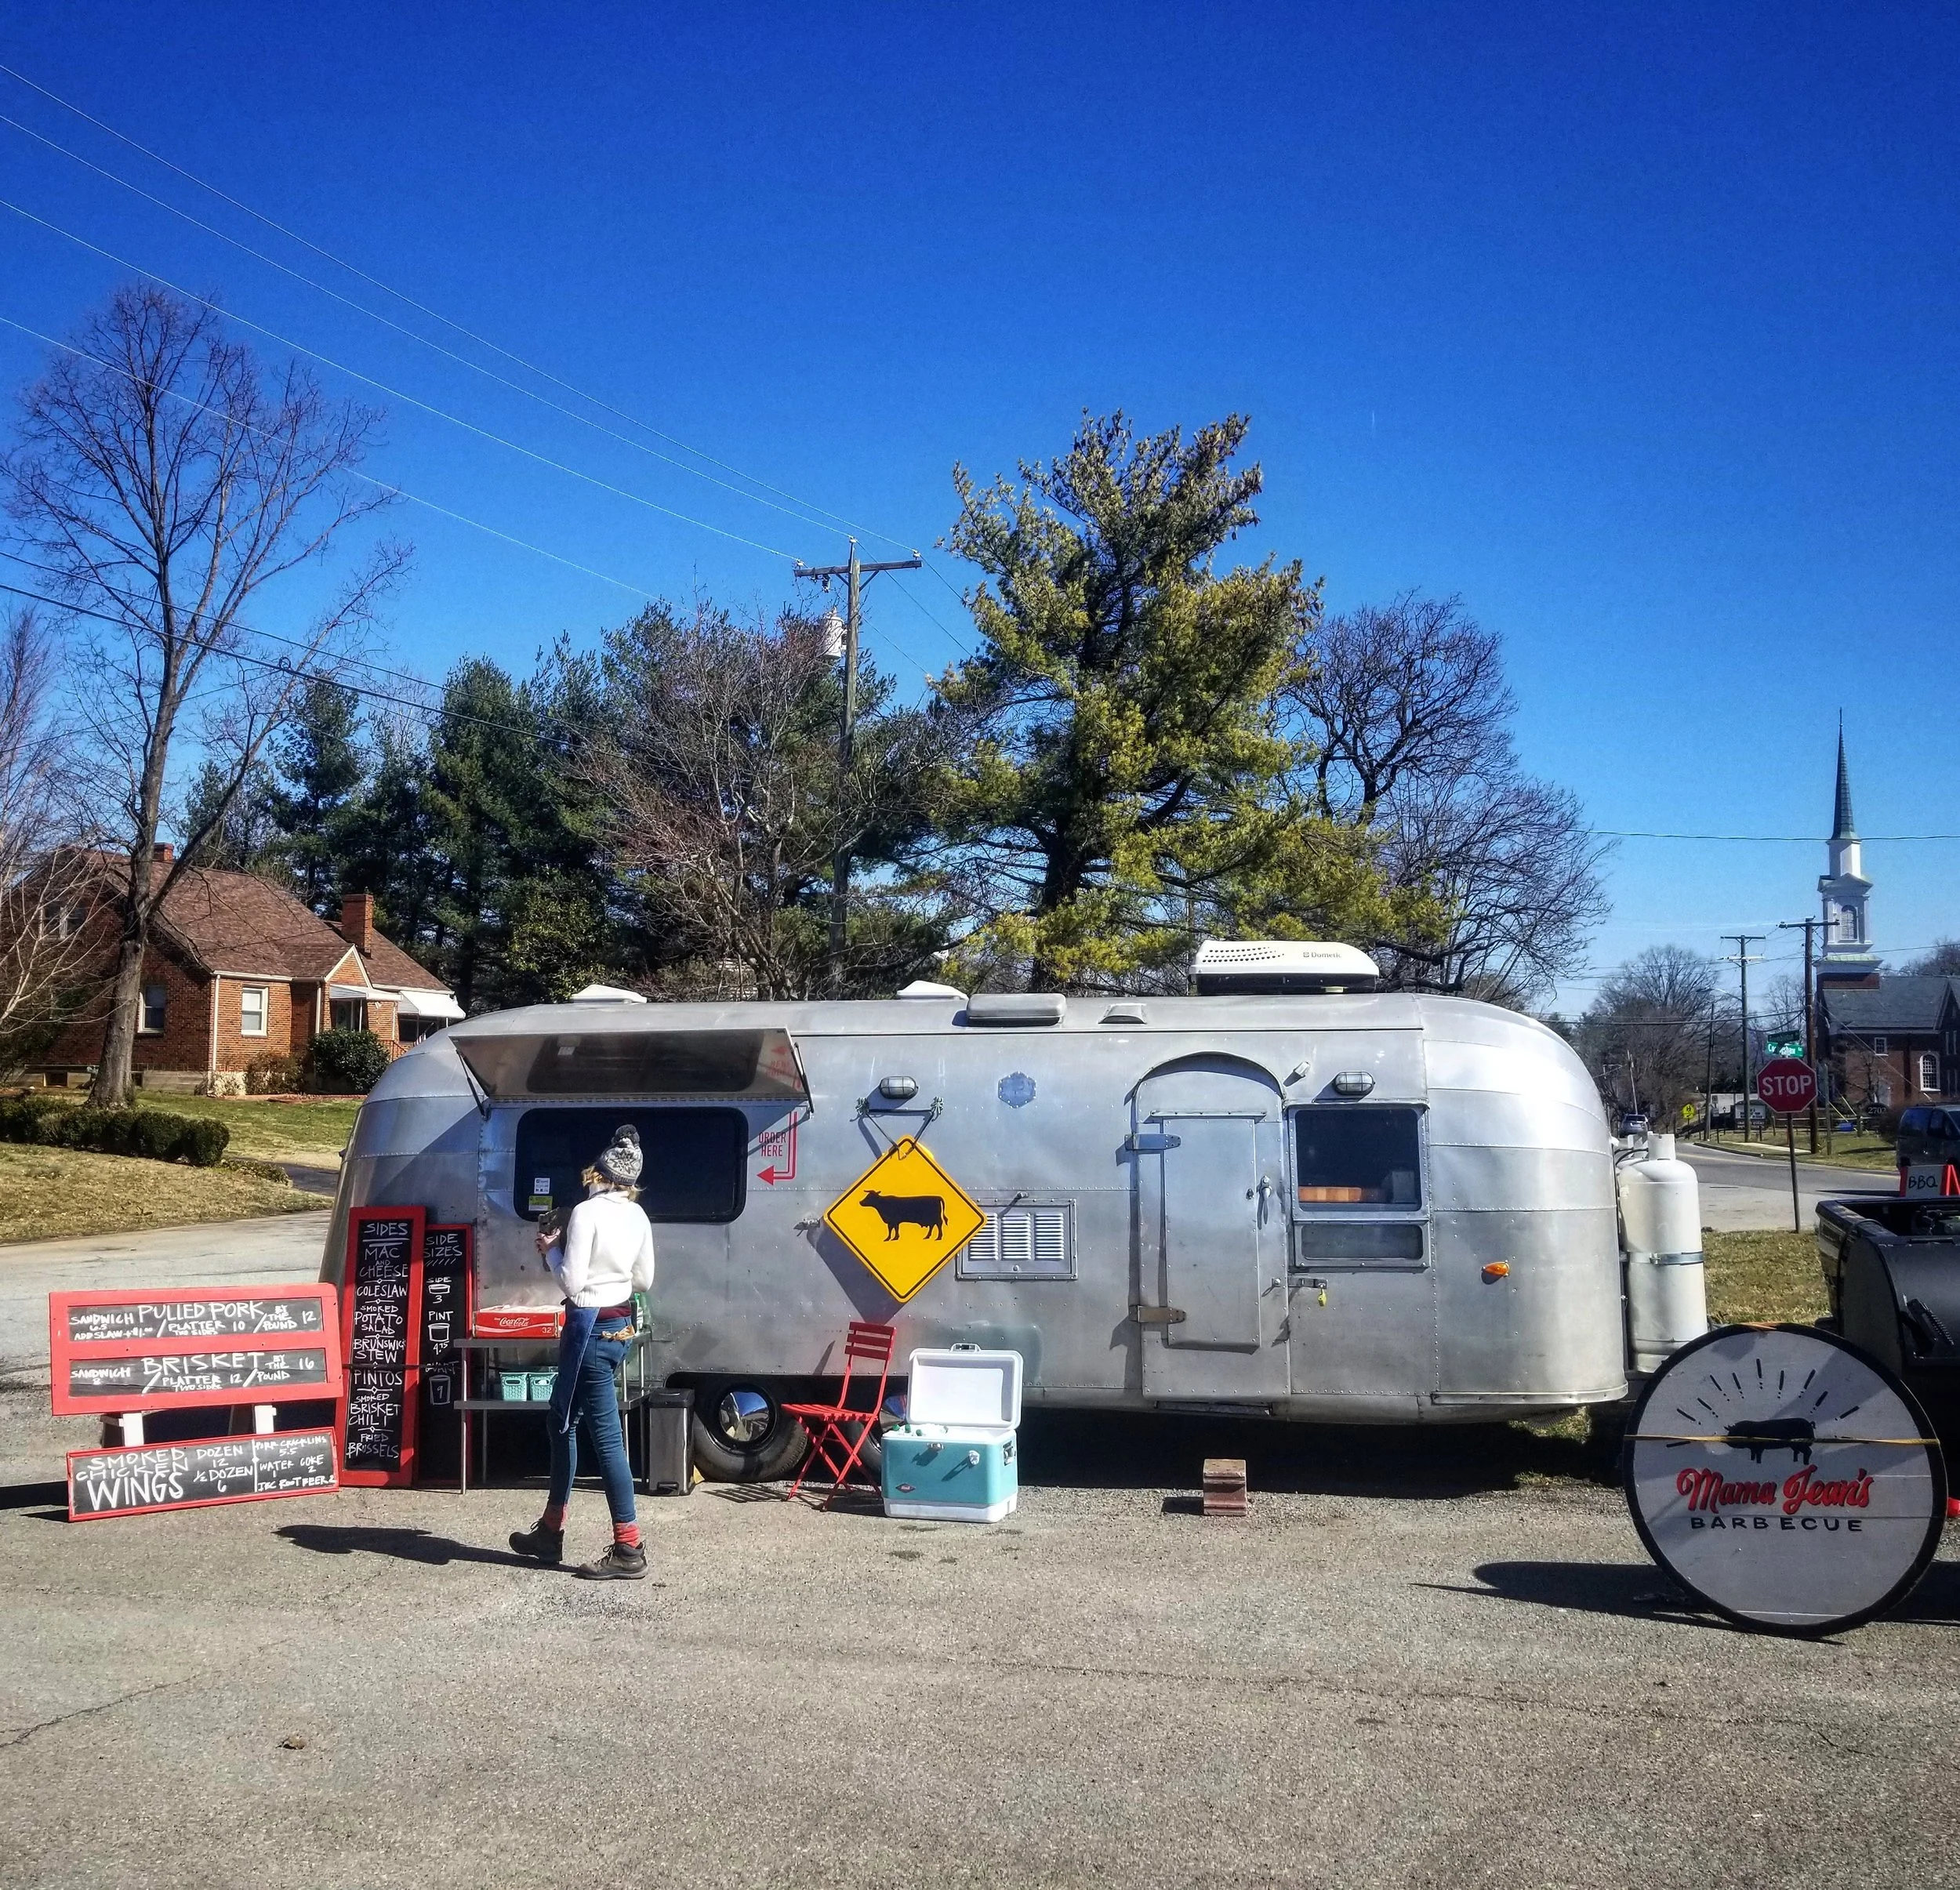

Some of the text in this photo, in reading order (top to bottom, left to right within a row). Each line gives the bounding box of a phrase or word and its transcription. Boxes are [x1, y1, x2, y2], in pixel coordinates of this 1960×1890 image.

[1762, 1075, 1812, 1096] STOP
[758, 1131, 786, 1144] ORDER
[760, 1145, 783, 1157] HERE
[1908, 1175, 1938, 1189] BBQ
[364, 1222, 408, 1235] SIDES
[426, 1233, 459, 1245] SIDE
[365, 1245, 400, 1261] MAC
[423, 1245, 463, 1258] SIZES
[359, 1263, 408, 1279] CHEESE
[357, 1283, 408, 1298] COLESLAW
[432, 1294, 443, 1304] 3
[138, 1300, 266, 1323] PULLED PORK
[274, 1304, 289, 1314] BY
[428, 1311, 454, 1321] PINT
[69, 1312, 134, 1325] SANDWICH
[268, 1312, 292, 1321] THE
[302, 1310, 317, 1325] 12
[354, 1311, 403, 1326] POTATO
[168, 1320, 245, 1332] PLATTER 10
[263, 1319, 298, 1331] POUND
[361, 1323, 395, 1335] SALAD
[74, 1331, 93, 1340] ADD
[93, 1330, 123, 1340] SLAW
[272, 1354, 285, 1363] BY
[299, 1356, 315, 1370] 16
[354, 1348, 397, 1364] STEW
[141, 1351, 265, 1376] BRISKET
[265, 1361, 290, 1369] THE
[70, 1366, 131, 1379] SANDWICH
[256, 1369, 291, 1383] POUND
[354, 1369, 403, 1387] PINTOS
[162, 1373, 243, 1387] PLATTER 12
[354, 1393, 390, 1403] SMOKED
[437, 1385, 444, 1399] 9
[350, 1402, 401, 1417] BRISKET
[348, 1413, 387, 1427] CHILI
[361, 1433, 389, 1442] FRIED
[196, 1445, 244, 1460] DOZEN
[346, 1442, 399, 1459] BRUSSELS
[87, 1447, 186, 1471] SMOKED
[212, 1457, 229, 1468] 12
[260, 1453, 325, 1471] WATER COKE
[75, 1456, 190, 1482] CHICKEN
[209, 1465, 253, 1482] DOZEN
[272, 1465, 318, 1478] 1 2
[86, 1471, 184, 1511] WINGS
[217, 1479, 227, 1493] 6
[1676, 1464, 1875, 1516] Mama Jean's
[1690, 1517, 1863, 1533] BARBECUE
